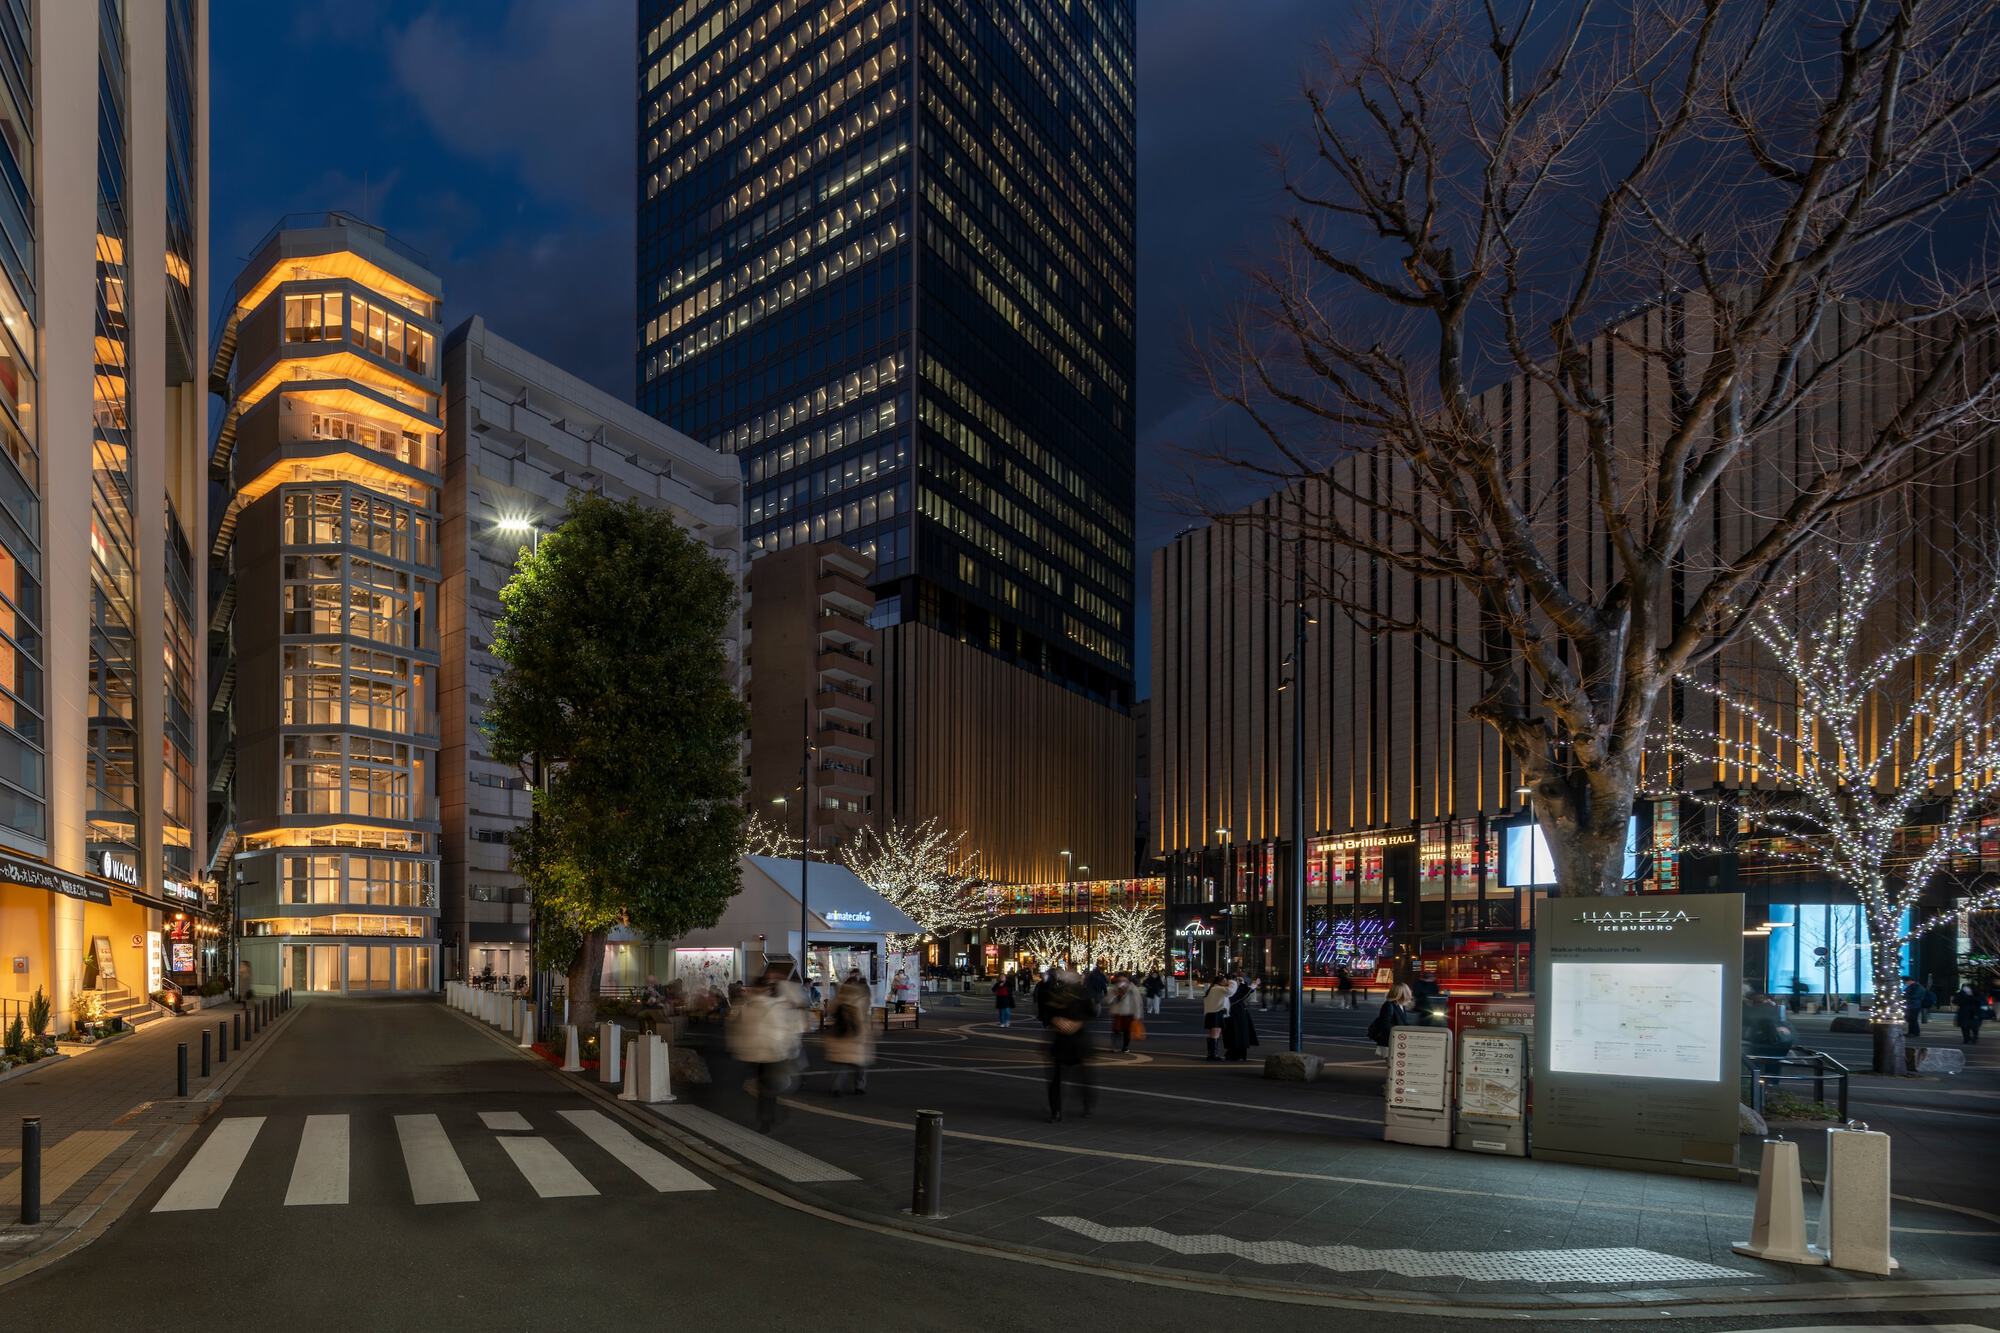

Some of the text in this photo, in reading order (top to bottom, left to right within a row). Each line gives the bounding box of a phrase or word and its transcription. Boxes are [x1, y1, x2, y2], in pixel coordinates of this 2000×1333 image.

[1344, 837, 1388, 849] Brillia
[1388, 835, 1416, 845] HALL
[111, 859, 137, 886] WACCA
[1582, 910, 1690, 923] HAREZA
